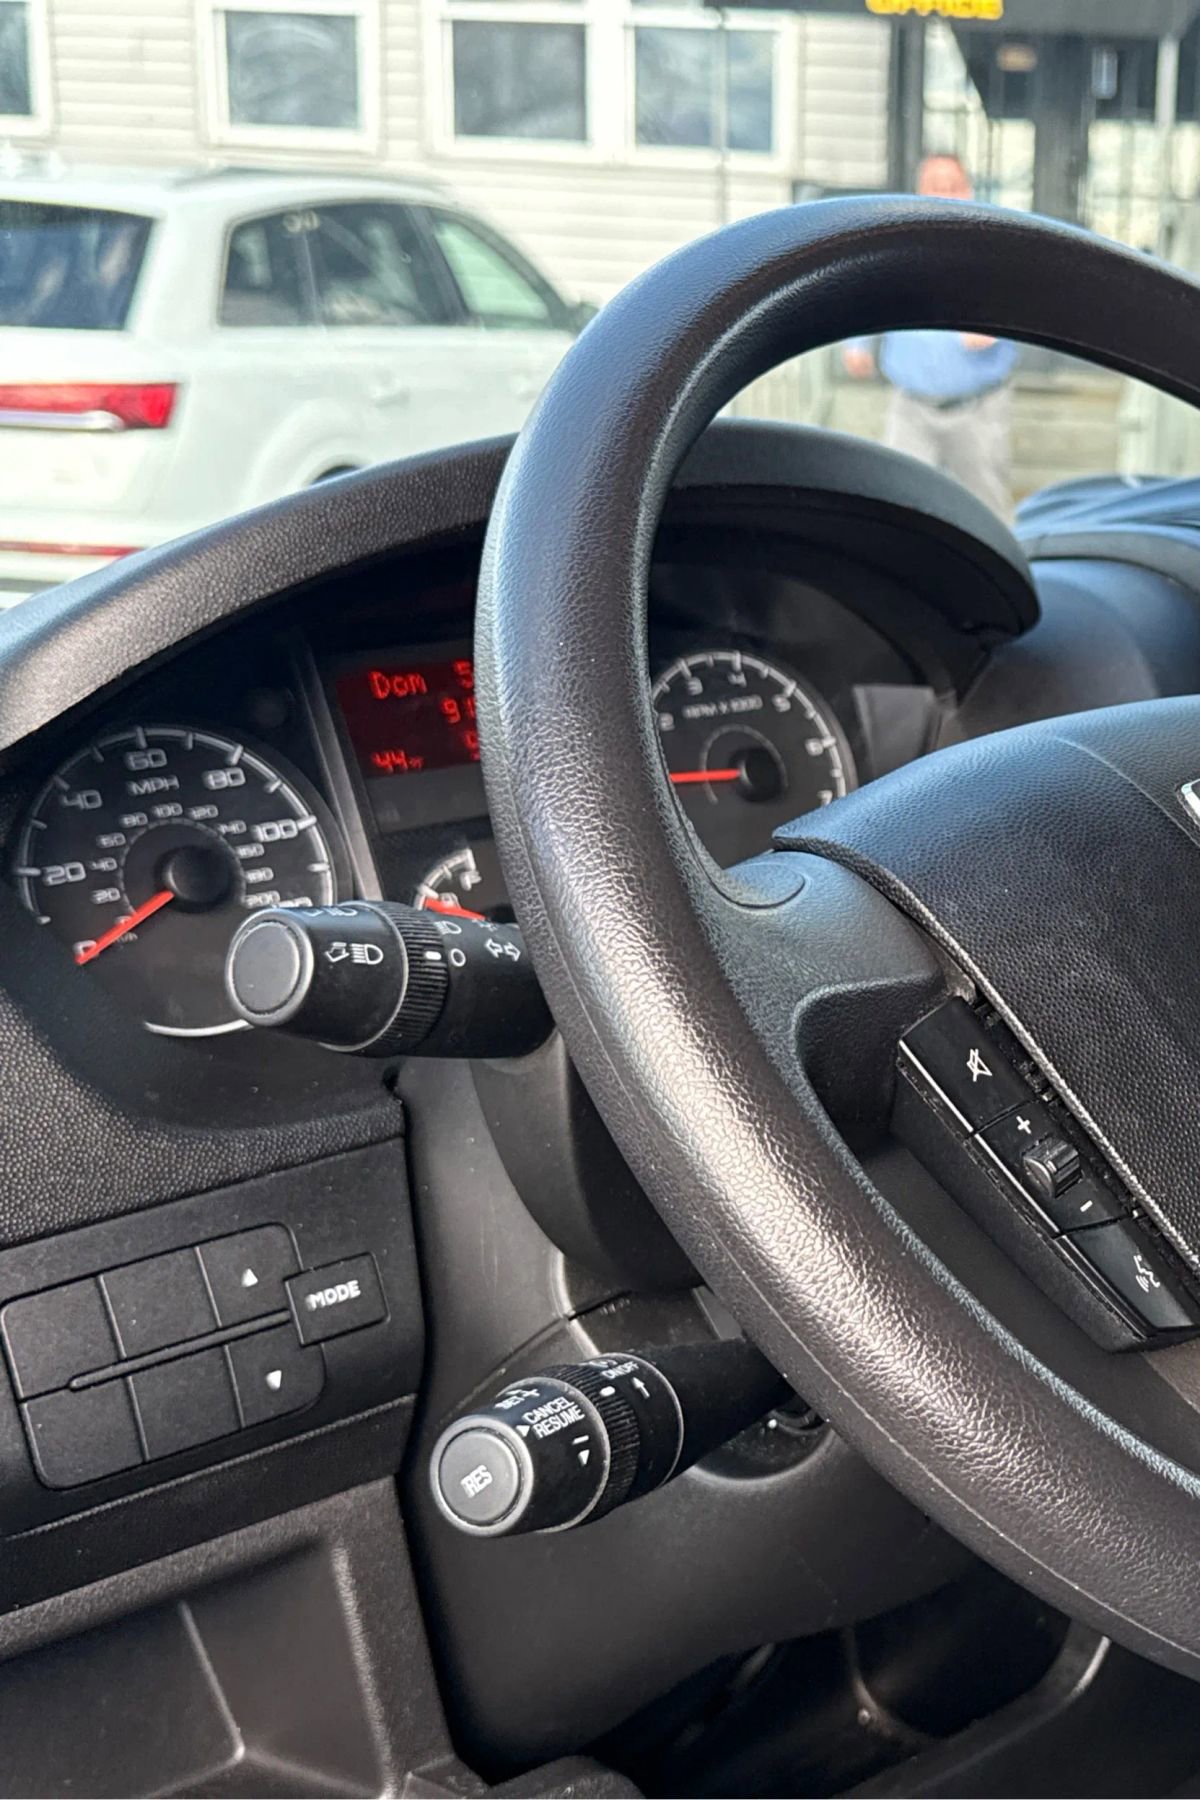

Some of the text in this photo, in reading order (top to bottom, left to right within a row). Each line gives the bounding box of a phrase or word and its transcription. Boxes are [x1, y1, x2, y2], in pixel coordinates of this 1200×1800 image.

[369, 671, 428, 699] Dom
[124, 748, 167, 770] 60
[128, 775, 179, 796] MPH
[202, 767, 246, 790] 80
[61, 789, 102, 810] 40
[152, 803, 183, 818] 100
[249, 819, 299, 842] 100
[42, 861, 87, 886] 20
[305, 1279, 362, 1312] MODE
[522, 1396, 576, 1424] CANCEL
[532, 1404, 586, 1440] RESUME
[460, 1464, 493, 1498] RES
